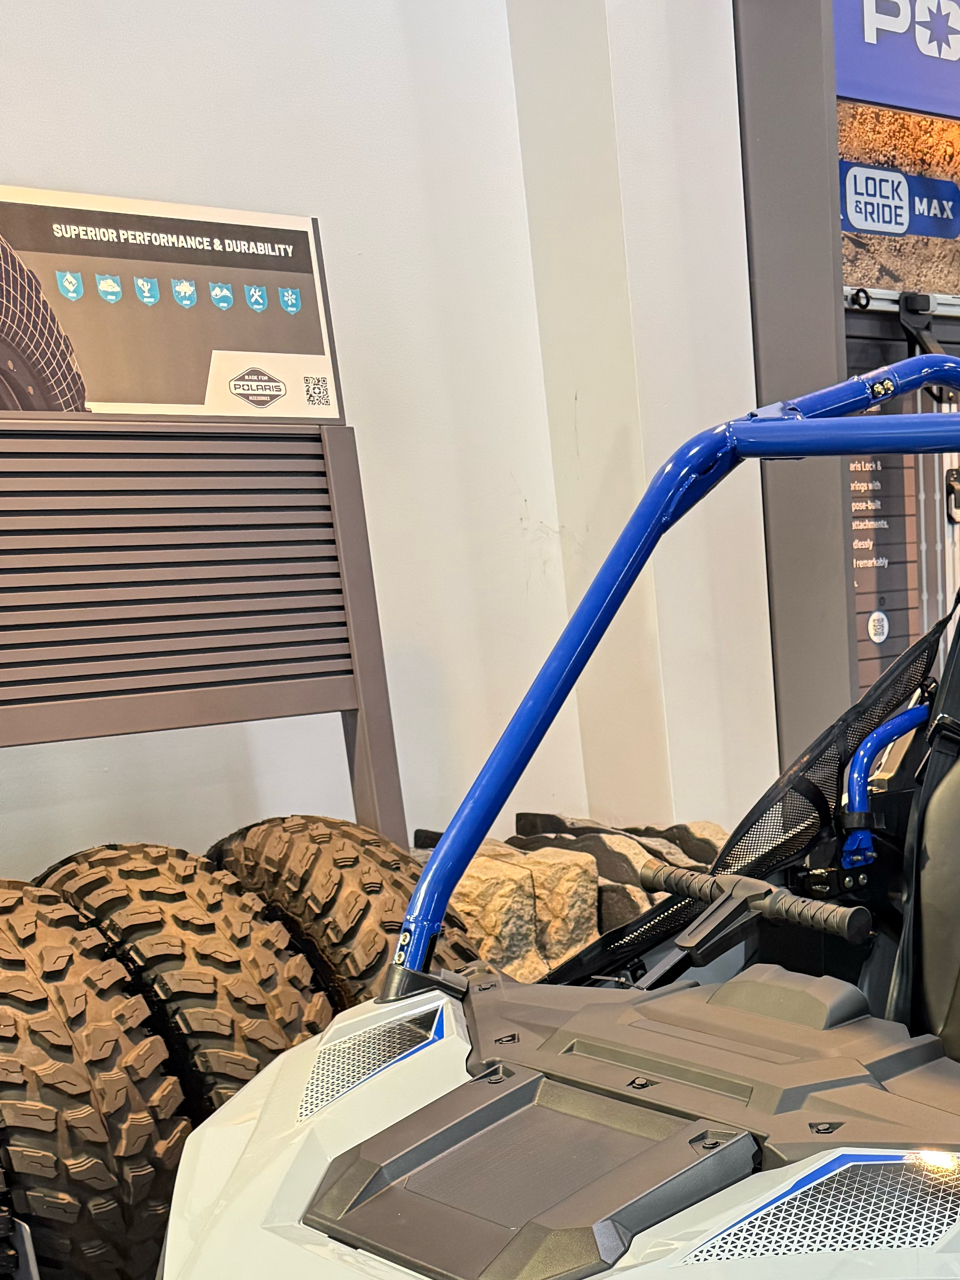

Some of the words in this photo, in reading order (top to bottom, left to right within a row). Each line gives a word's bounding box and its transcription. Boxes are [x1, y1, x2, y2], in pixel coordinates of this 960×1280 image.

[853, 174, 903, 202] LOCK
[914, 196, 954, 220] MAX
[52, 223, 118, 243] SUPERIOR
[120, 230, 212, 251] PERFORMANCE
[213, 238, 223, 251] &
[224, 239, 294, 257] DURABILITY
[233, 383, 282, 393] POLARIS
[862, 461, 876, 471] Lock
[868, 481, 881, 490] with
